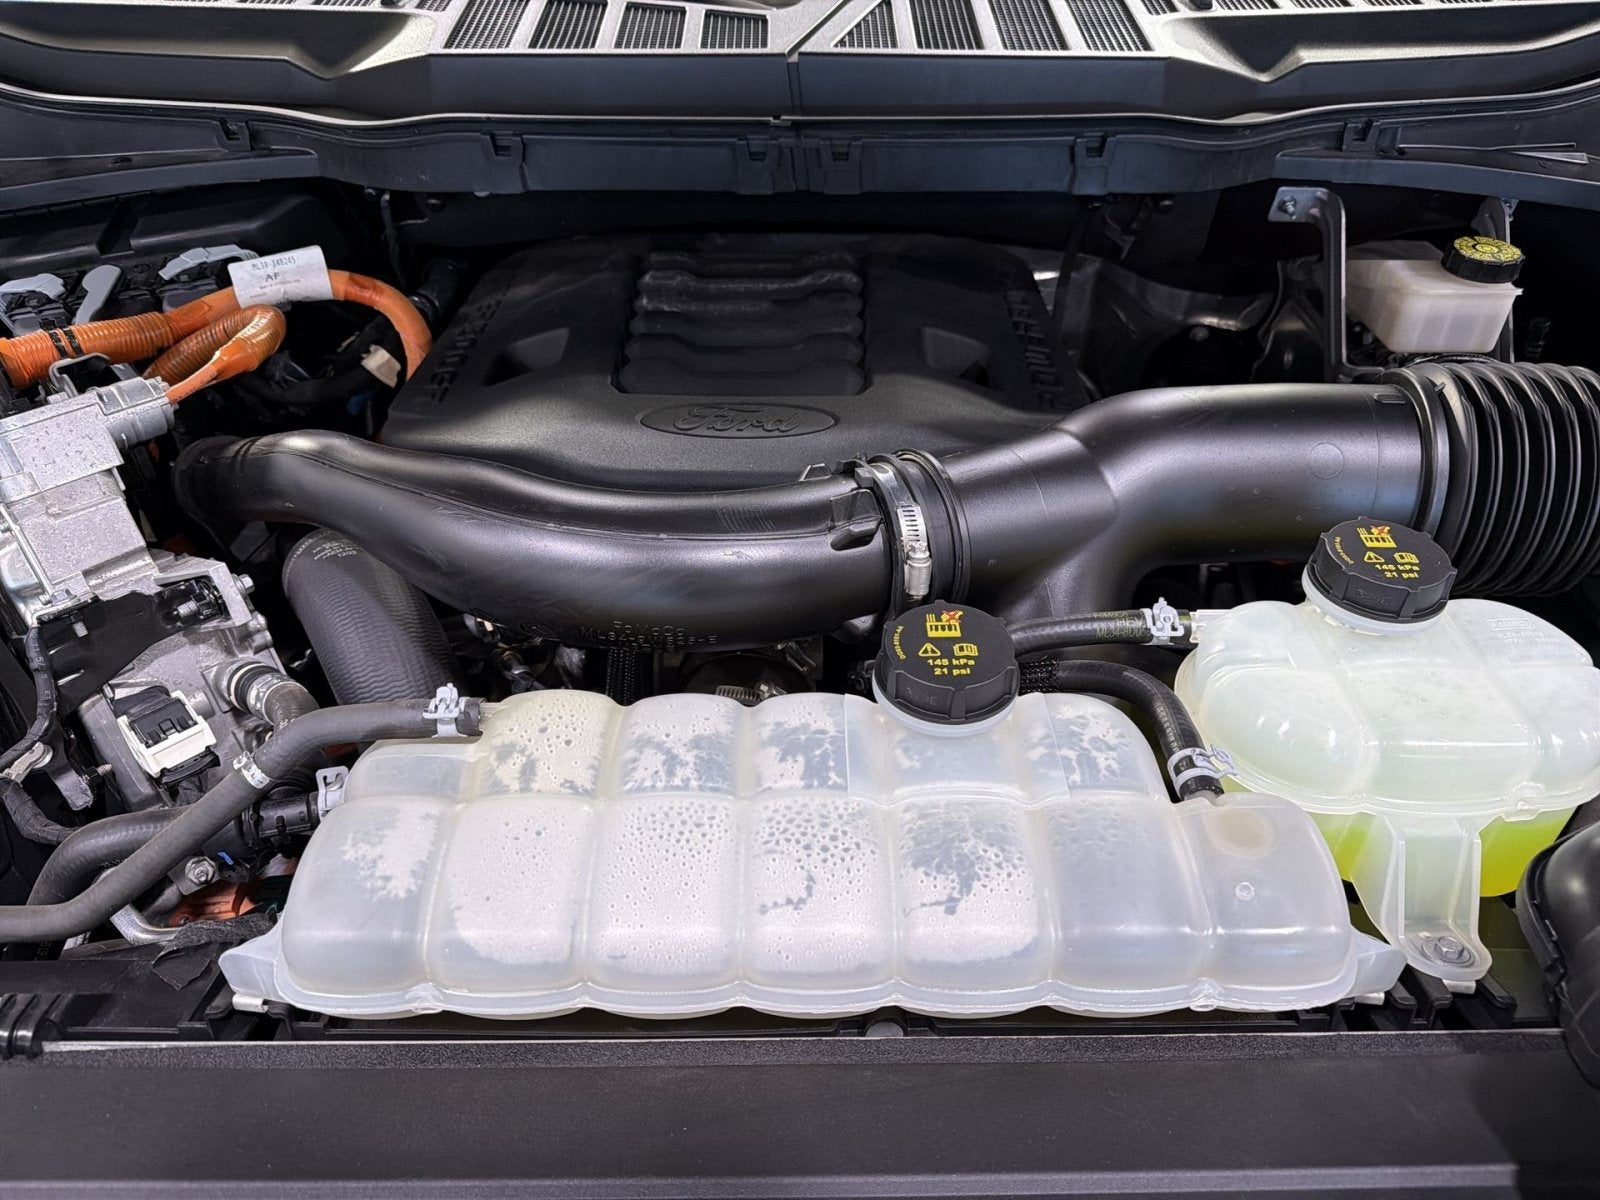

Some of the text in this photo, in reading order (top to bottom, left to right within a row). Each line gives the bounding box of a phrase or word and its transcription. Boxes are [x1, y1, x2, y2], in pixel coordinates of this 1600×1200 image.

[265, 272, 280, 281] AF
[673, 404, 800, 432] Ford
[952, 668, 971, 676] psi
